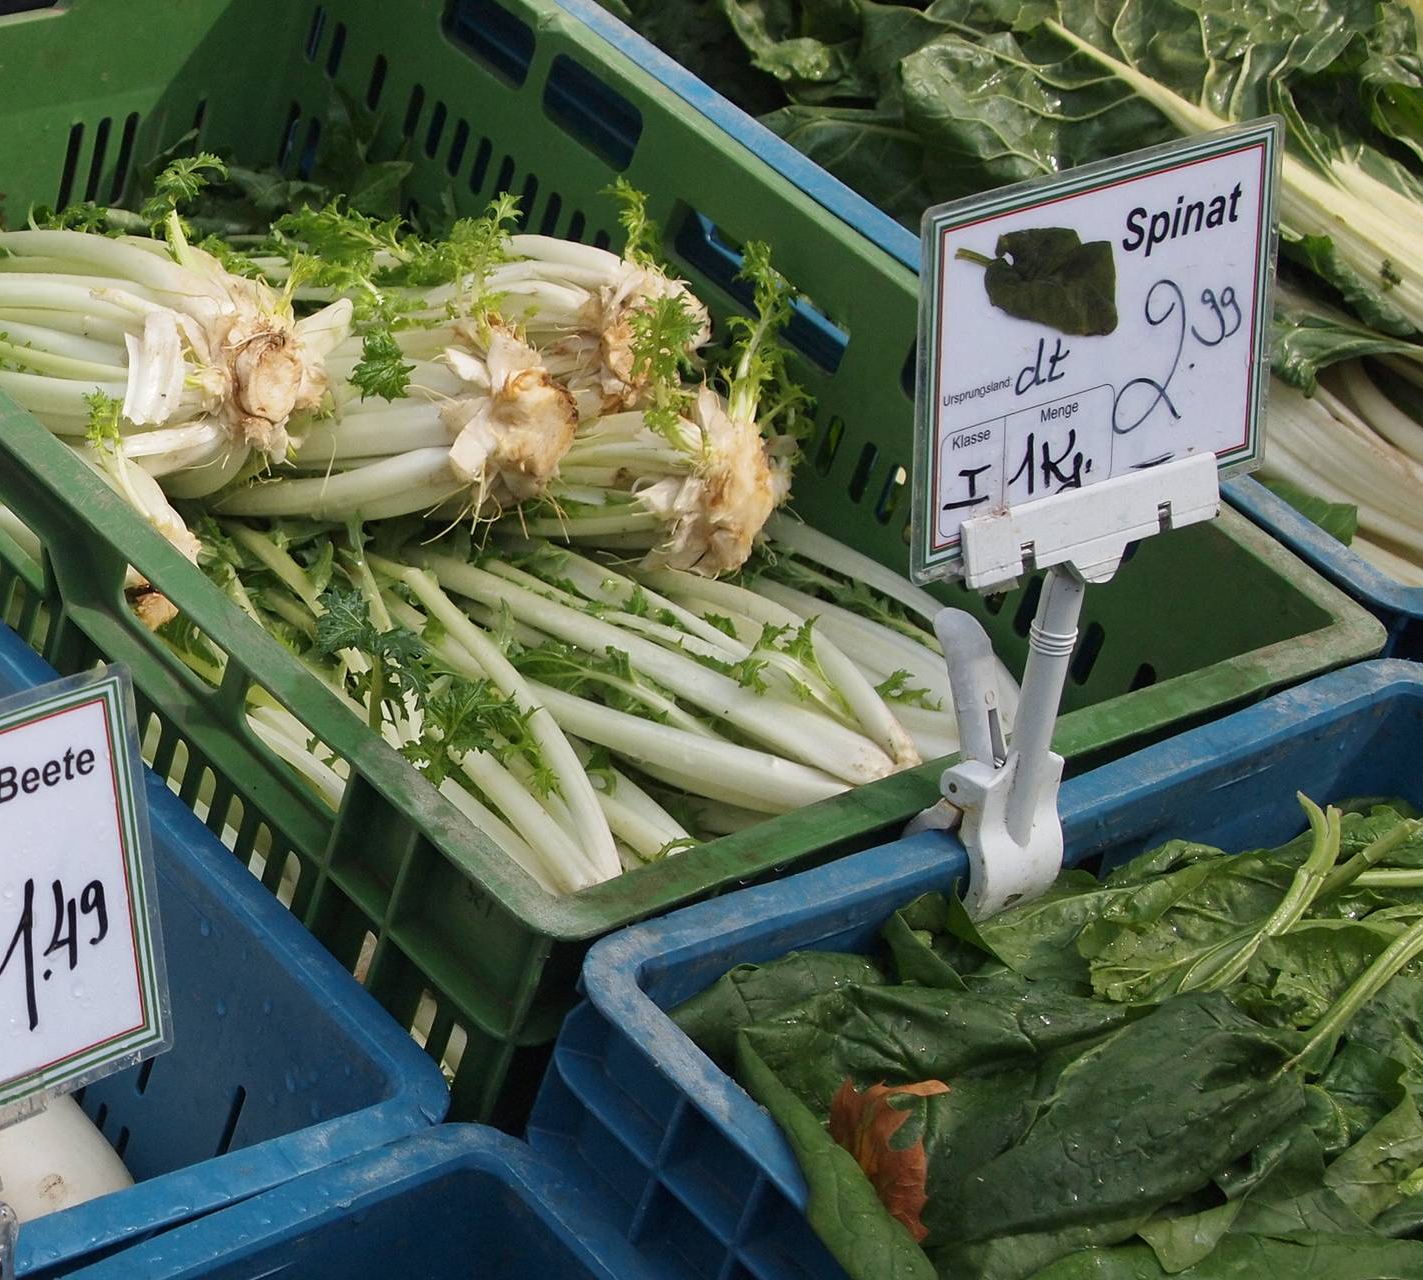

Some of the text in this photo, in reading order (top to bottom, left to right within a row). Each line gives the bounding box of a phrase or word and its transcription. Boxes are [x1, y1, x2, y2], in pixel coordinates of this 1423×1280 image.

[1122, 183, 1242, 257] Spinat
[943, 337, 1070, 407] Ursprungsland: dt
[1112, 279, 1242, 435] 2.99
[951, 428, 992, 451] Klasse
[1040, 401, 1079, 423] Menge
